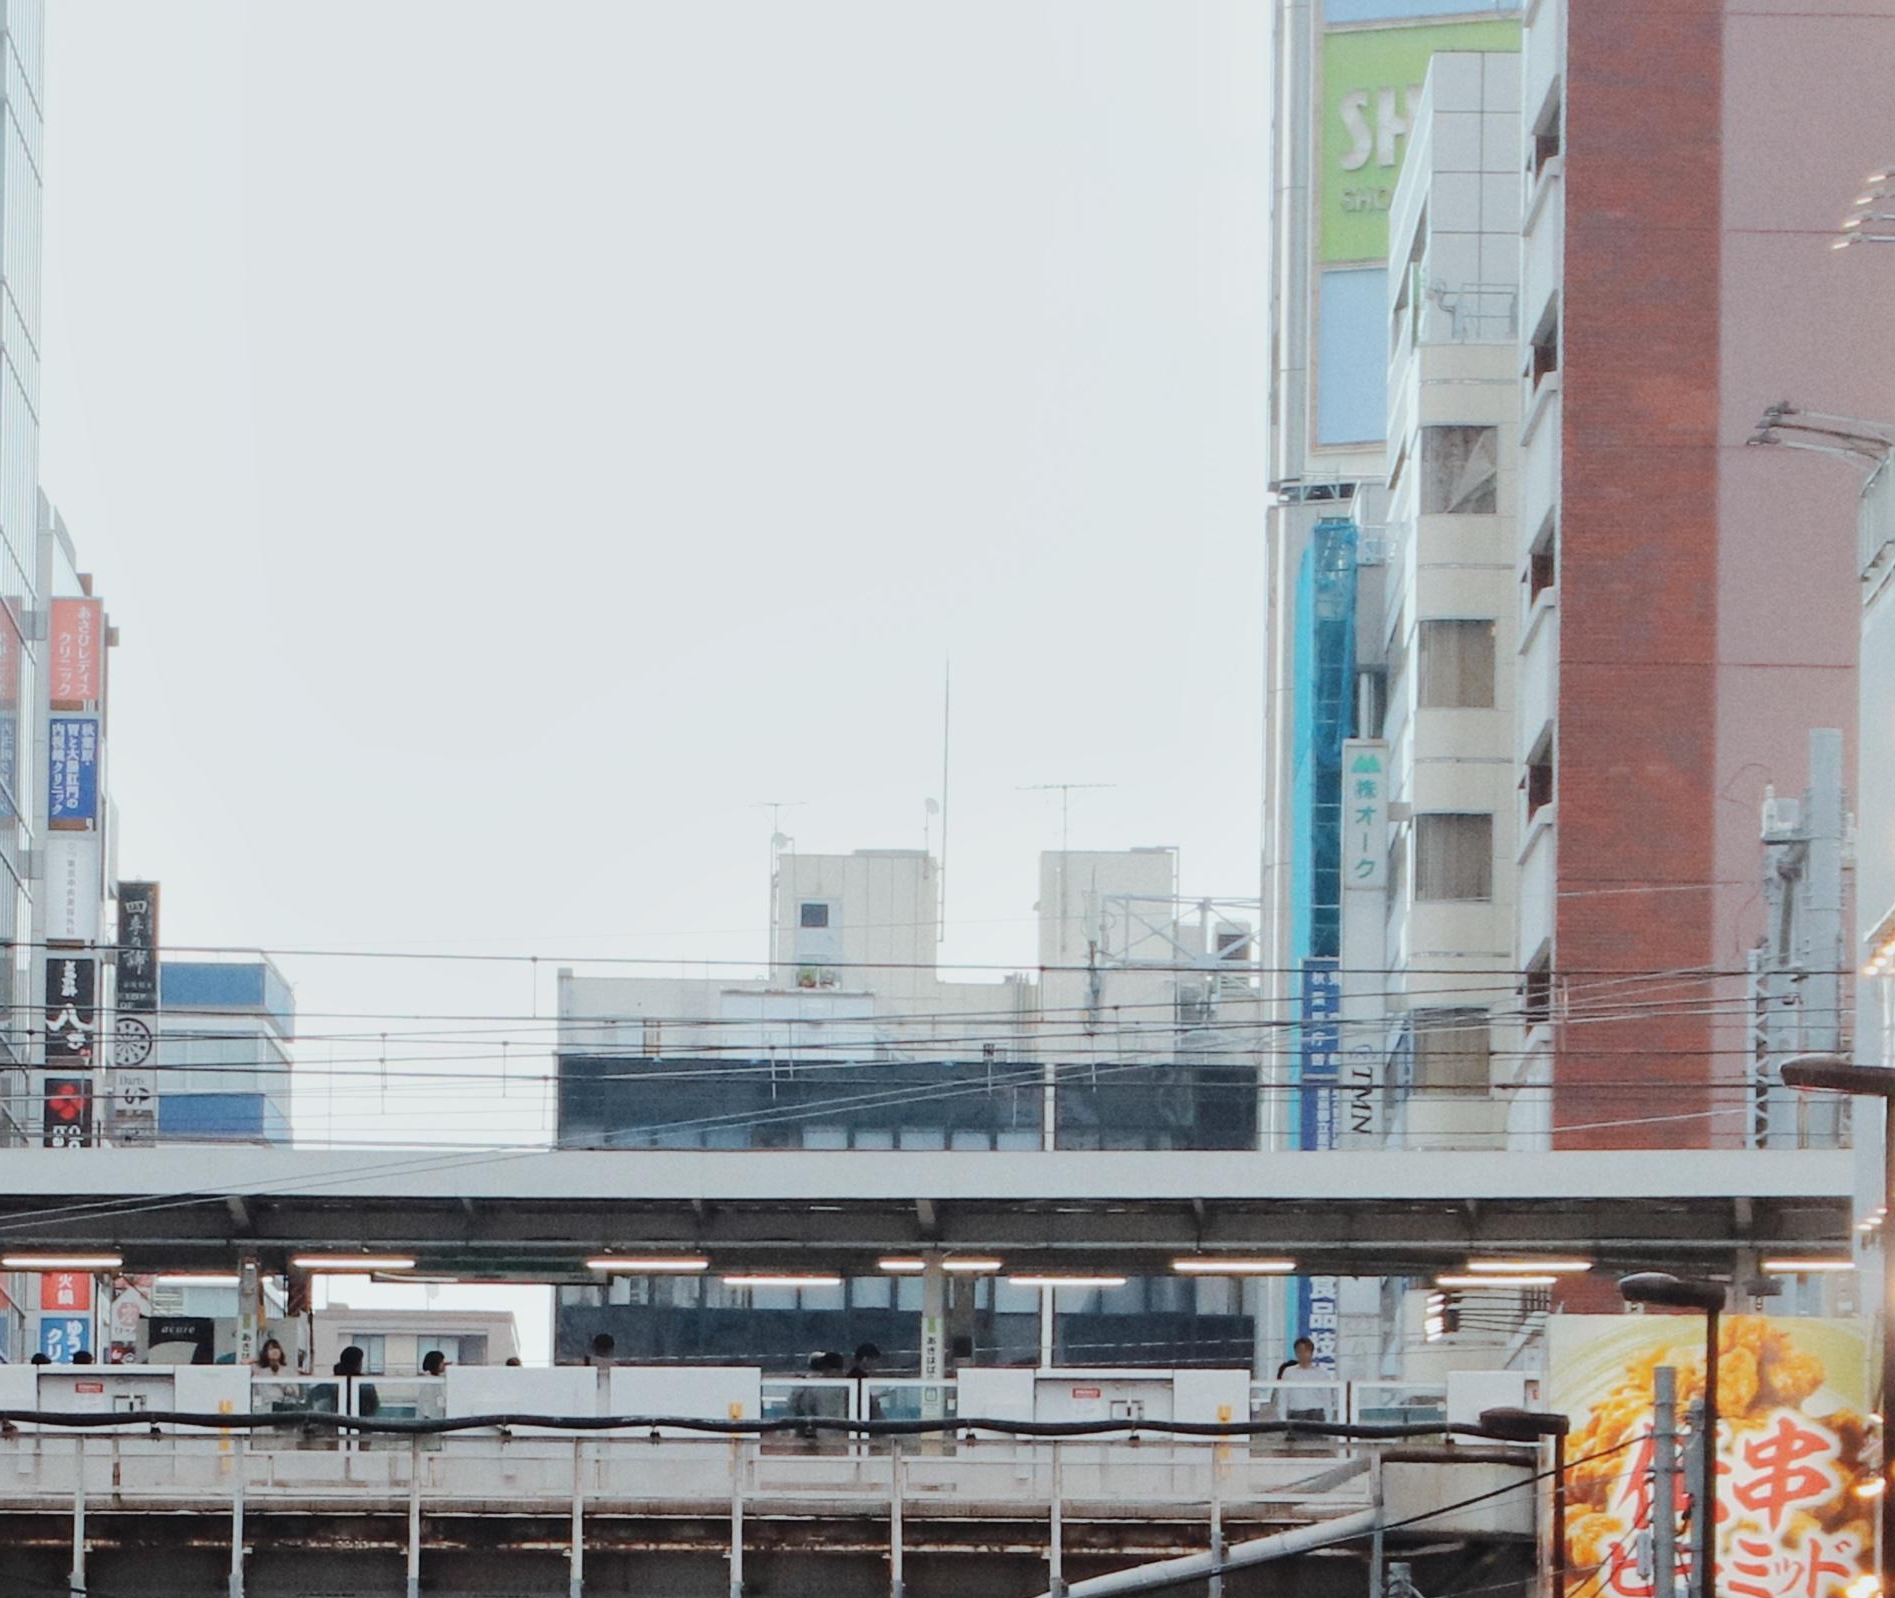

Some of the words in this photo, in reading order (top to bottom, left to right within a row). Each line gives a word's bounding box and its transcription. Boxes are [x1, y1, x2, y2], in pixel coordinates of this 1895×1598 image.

[1337, 85, 1422, 172] SH
[57, 632, 72, 694] クリニック
[77, 606, 92, 695] あさひレディス
[925, 1336, 937, 1379] あきはば
